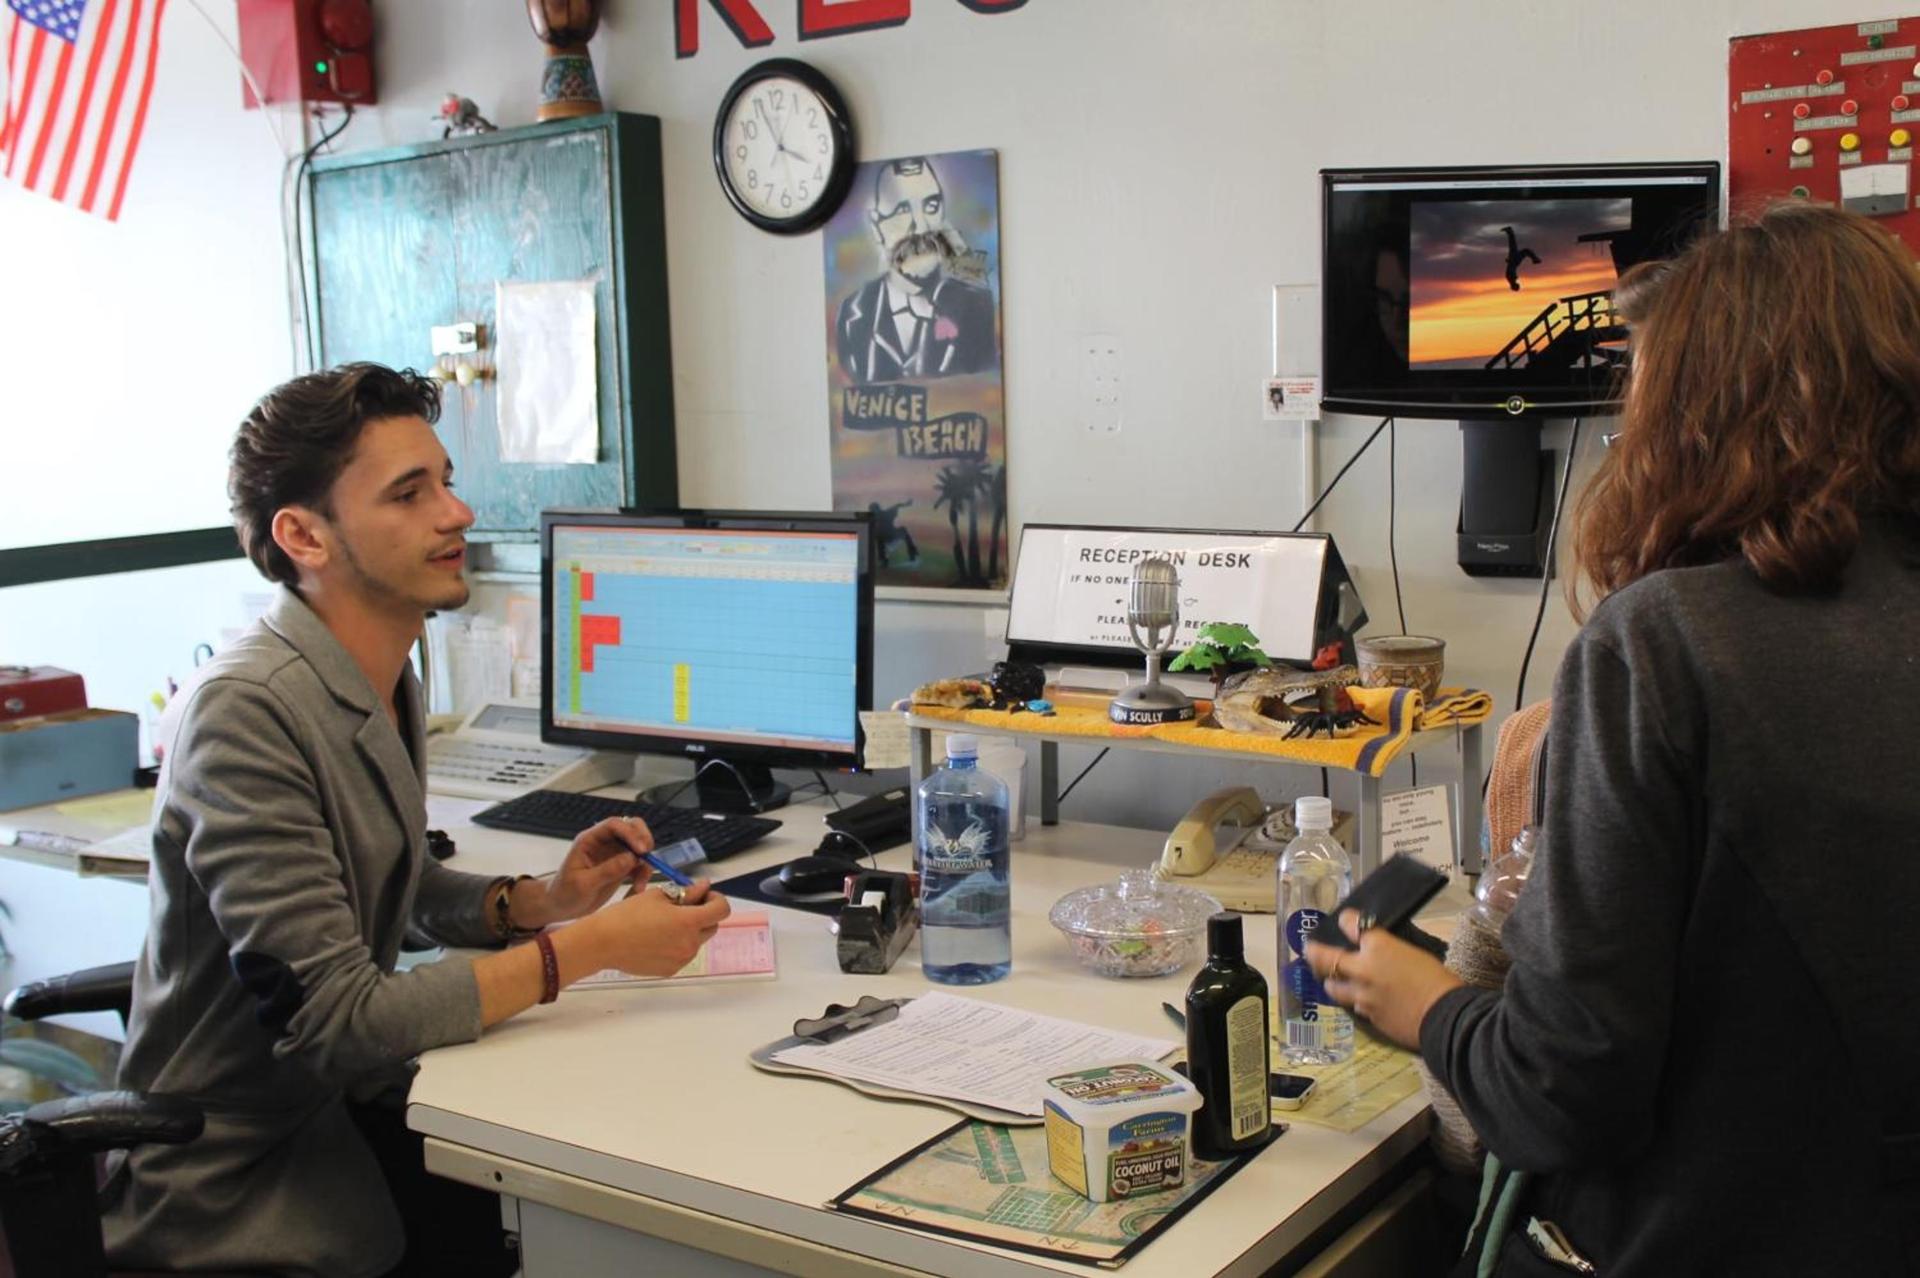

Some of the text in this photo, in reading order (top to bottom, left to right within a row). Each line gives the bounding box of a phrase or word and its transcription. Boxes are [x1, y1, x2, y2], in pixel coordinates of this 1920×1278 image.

[767, 90, 785, 110] 12
[793, 93, 799, 114] 1
[807, 108, 817, 129] 2
[741, 120, 758, 140] 10
[818, 133, 829, 154] 3
[736, 145, 748, 164] 9
[748, 170, 758, 189] 8
[813, 164, 824, 181] 4
[764, 183, 775, 204] 7
[780, 188, 792, 208] 6
[799, 180, 809, 200] 5
[846, 389, 923, 422] VENICE
[902, 419, 983, 455] BEACH
[1198, 552, 1251, 569] DESK
[1071, 574, 1130, 585] IF NO ONE
[1097, 614, 1126, 625] PLEA
[1129, 710, 1163, 723] SCULLY
[1393, 835, 1430, 849] Welcome
[1115, 1159, 1163, 1178] COCONUT
[1164, 1156, 1180, 1169] OIL
